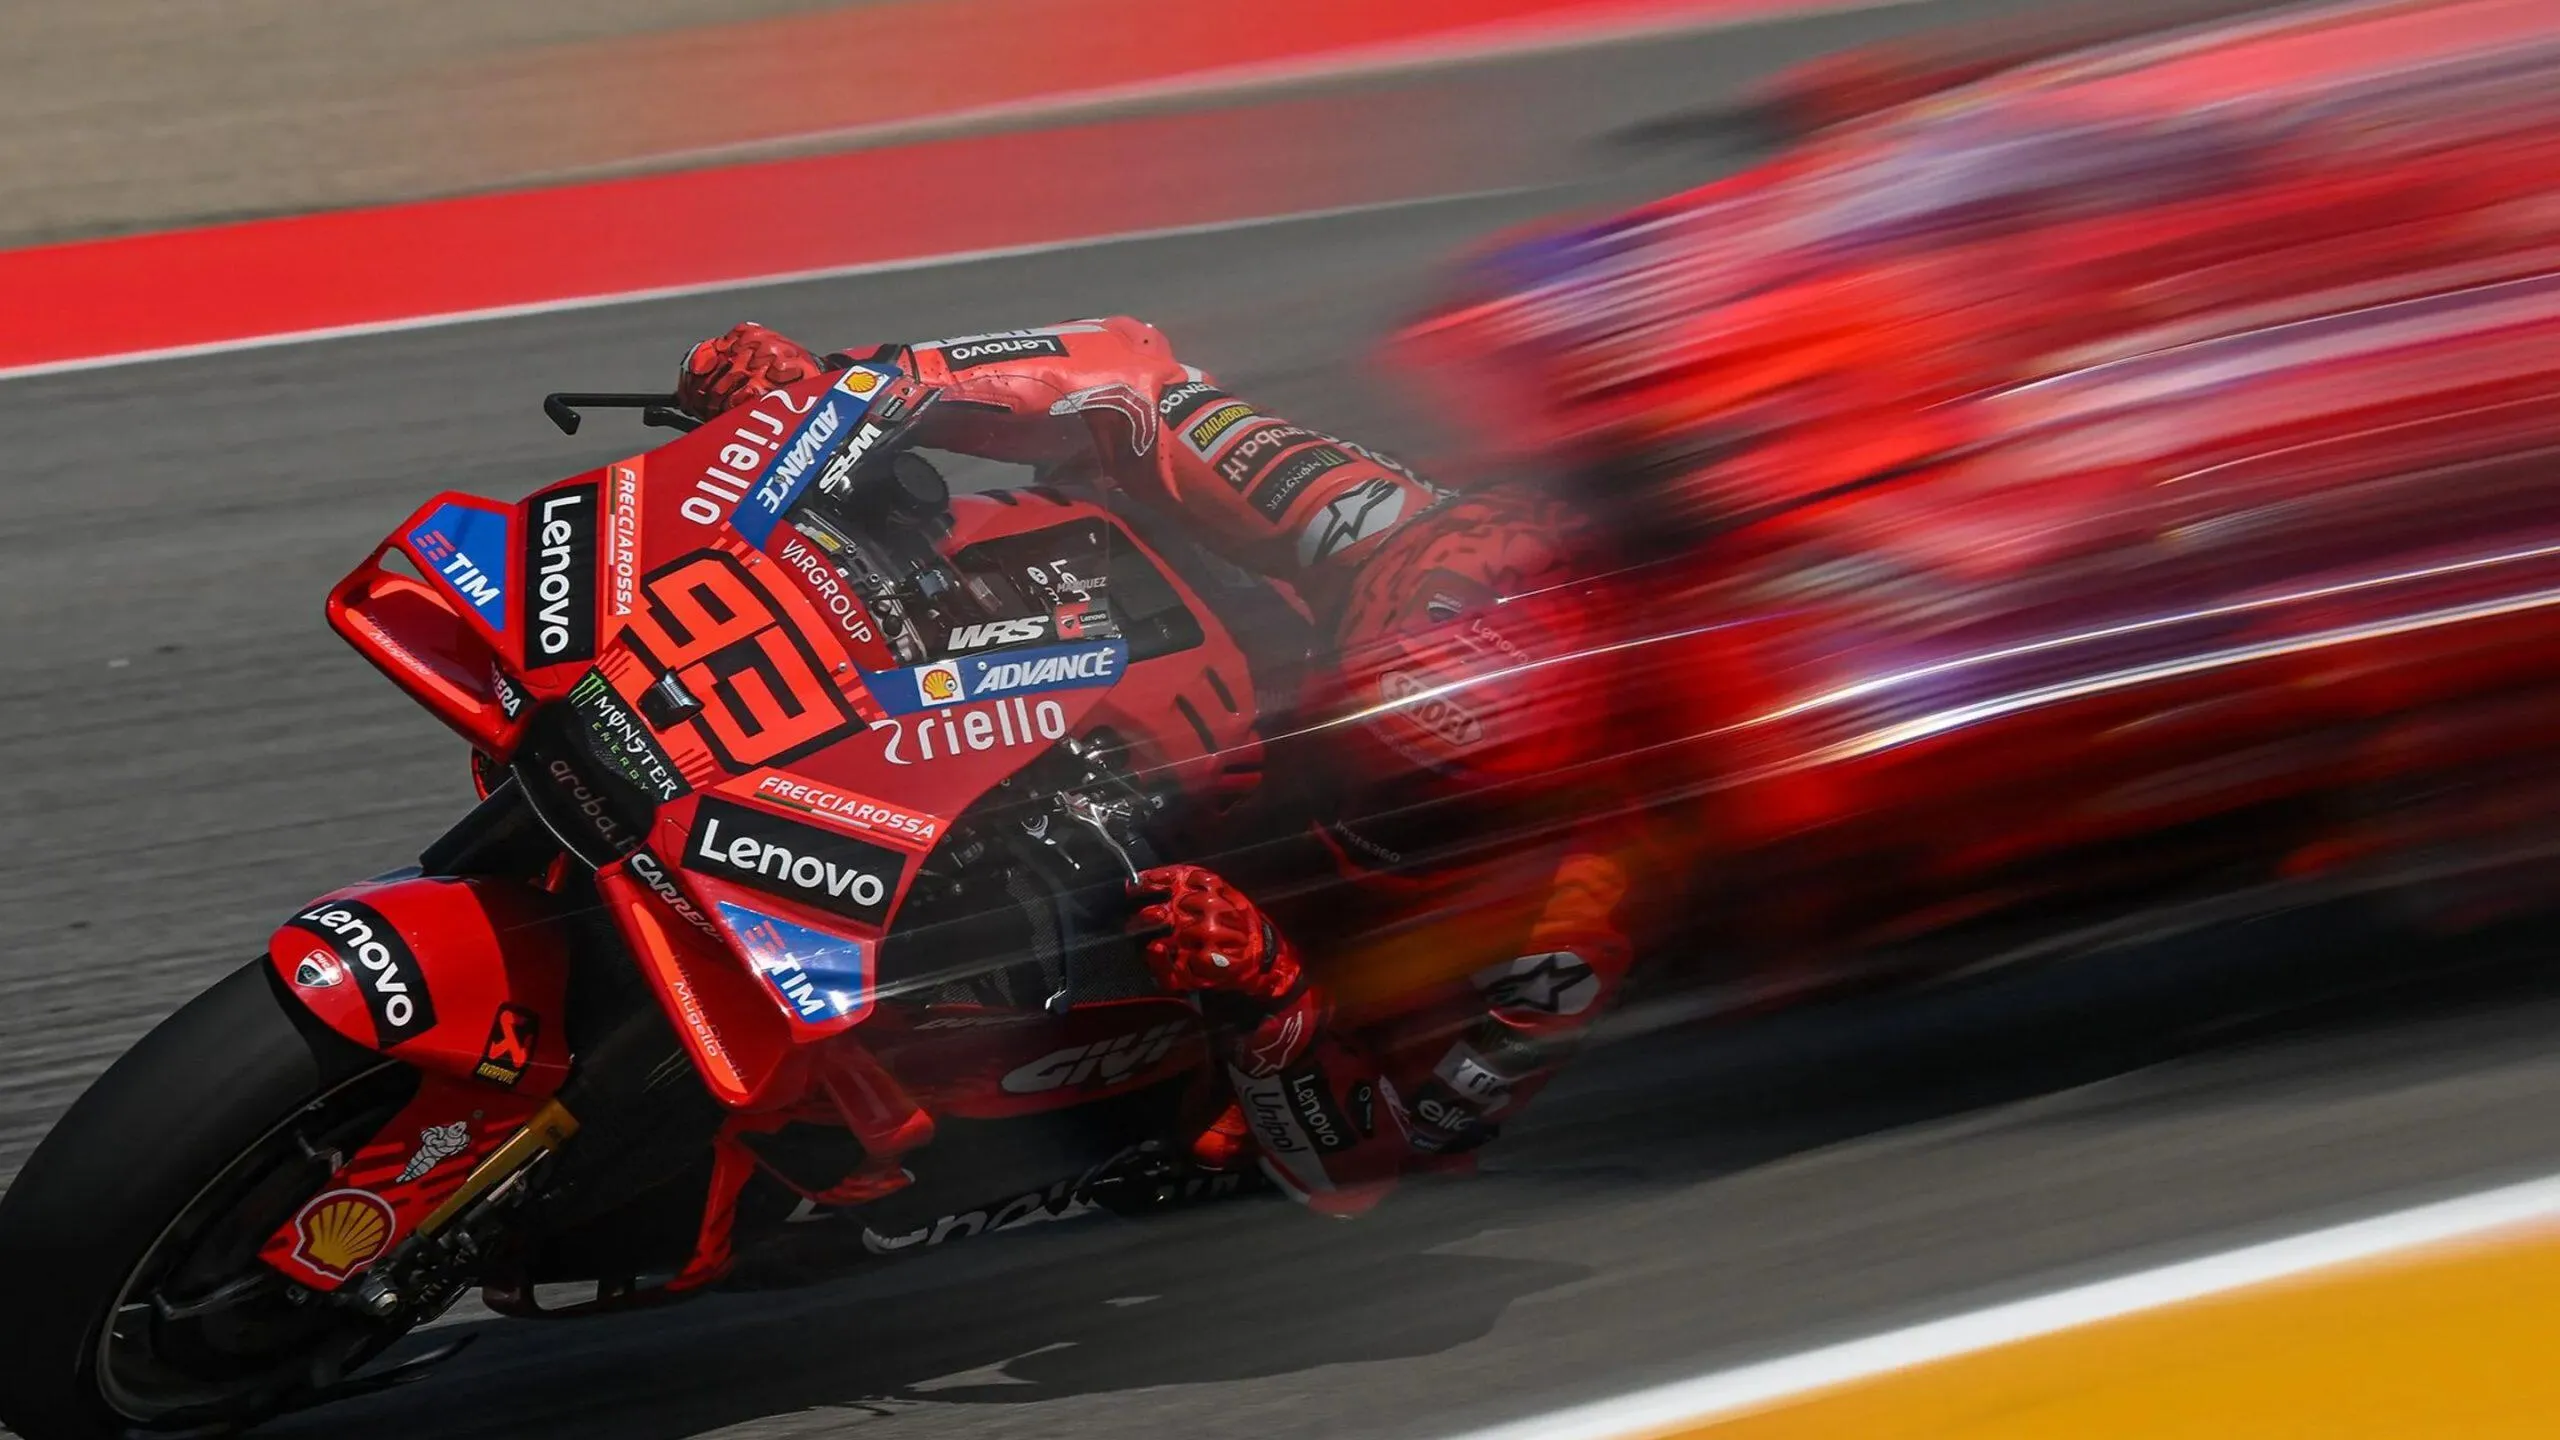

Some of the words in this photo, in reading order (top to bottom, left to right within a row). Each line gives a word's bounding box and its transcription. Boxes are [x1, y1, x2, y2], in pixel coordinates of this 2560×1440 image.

[951, 338, 1057, 361] Lenovo
[680, 408, 785, 526] riello
[757, 401, 840, 513] ADVANCE
[818, 422, 882, 494] WRS
[538, 494, 582, 655] Lenovo
[615, 467, 636, 617] FRECCIAROSSA
[449, 552, 501, 607] TIM
[780, 538, 874, 645] VARGROUP
[1056, 577, 1107, 593] MARQUEZ
[949, 615, 1049, 651] WRS
[1080, 613, 1106, 622] Lenovo
[1471, 619, 1529, 663] Lenovo
[642, 550, 862, 770] 93
[973, 648, 1114, 696] ADVANCE
[591, 719, 650, 791] ENERGY
[596, 696, 678, 801] MONSTER
[917, 696, 1067, 761] riello
[758, 775, 938, 840] FRECCIAROSSA
[698, 817, 885, 907] Lenovo
[300, 903, 414, 1027] Lenovo
[763, 952, 827, 1018] TIM
[672, 981, 719, 1057] Mugello
[1251, 1092, 1309, 1153] Unipol
[1292, 1073, 1340, 1146] Lenovo
